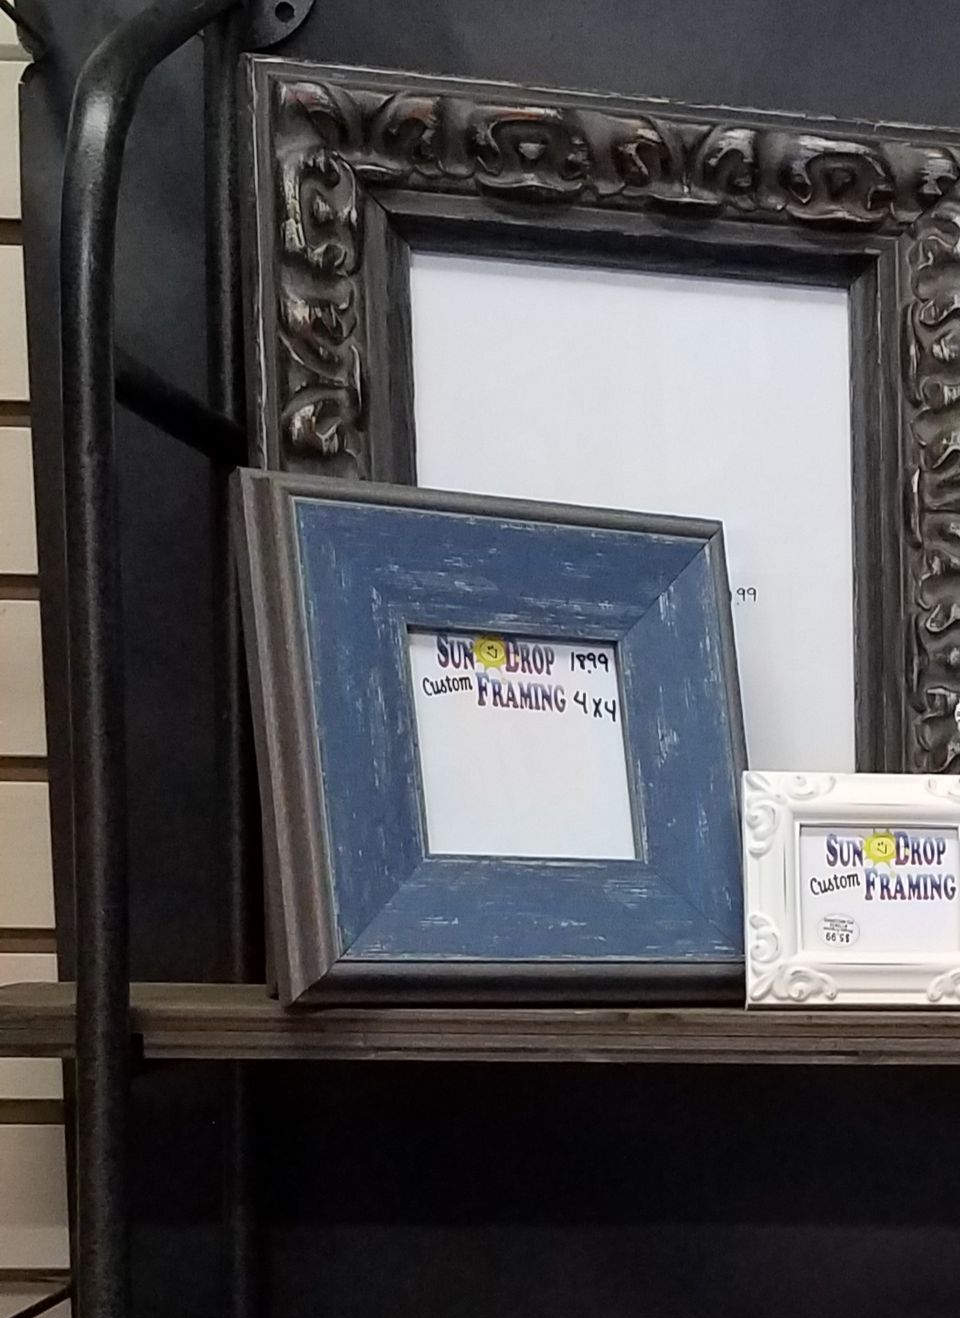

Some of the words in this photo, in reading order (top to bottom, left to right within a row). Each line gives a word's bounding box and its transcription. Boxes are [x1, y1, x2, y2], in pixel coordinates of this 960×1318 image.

[436, 634, 475, 671] SUN
[505, 638, 555, 675] DROP
[423, 675, 473, 696] Custom
[475, 671, 566, 713] FRAMING
[826, 833, 864, 867] SUN
[894, 831, 946, 866] DROP
[810, 873, 860, 896] Custom
[864, 868, 956, 901] FRAMING
